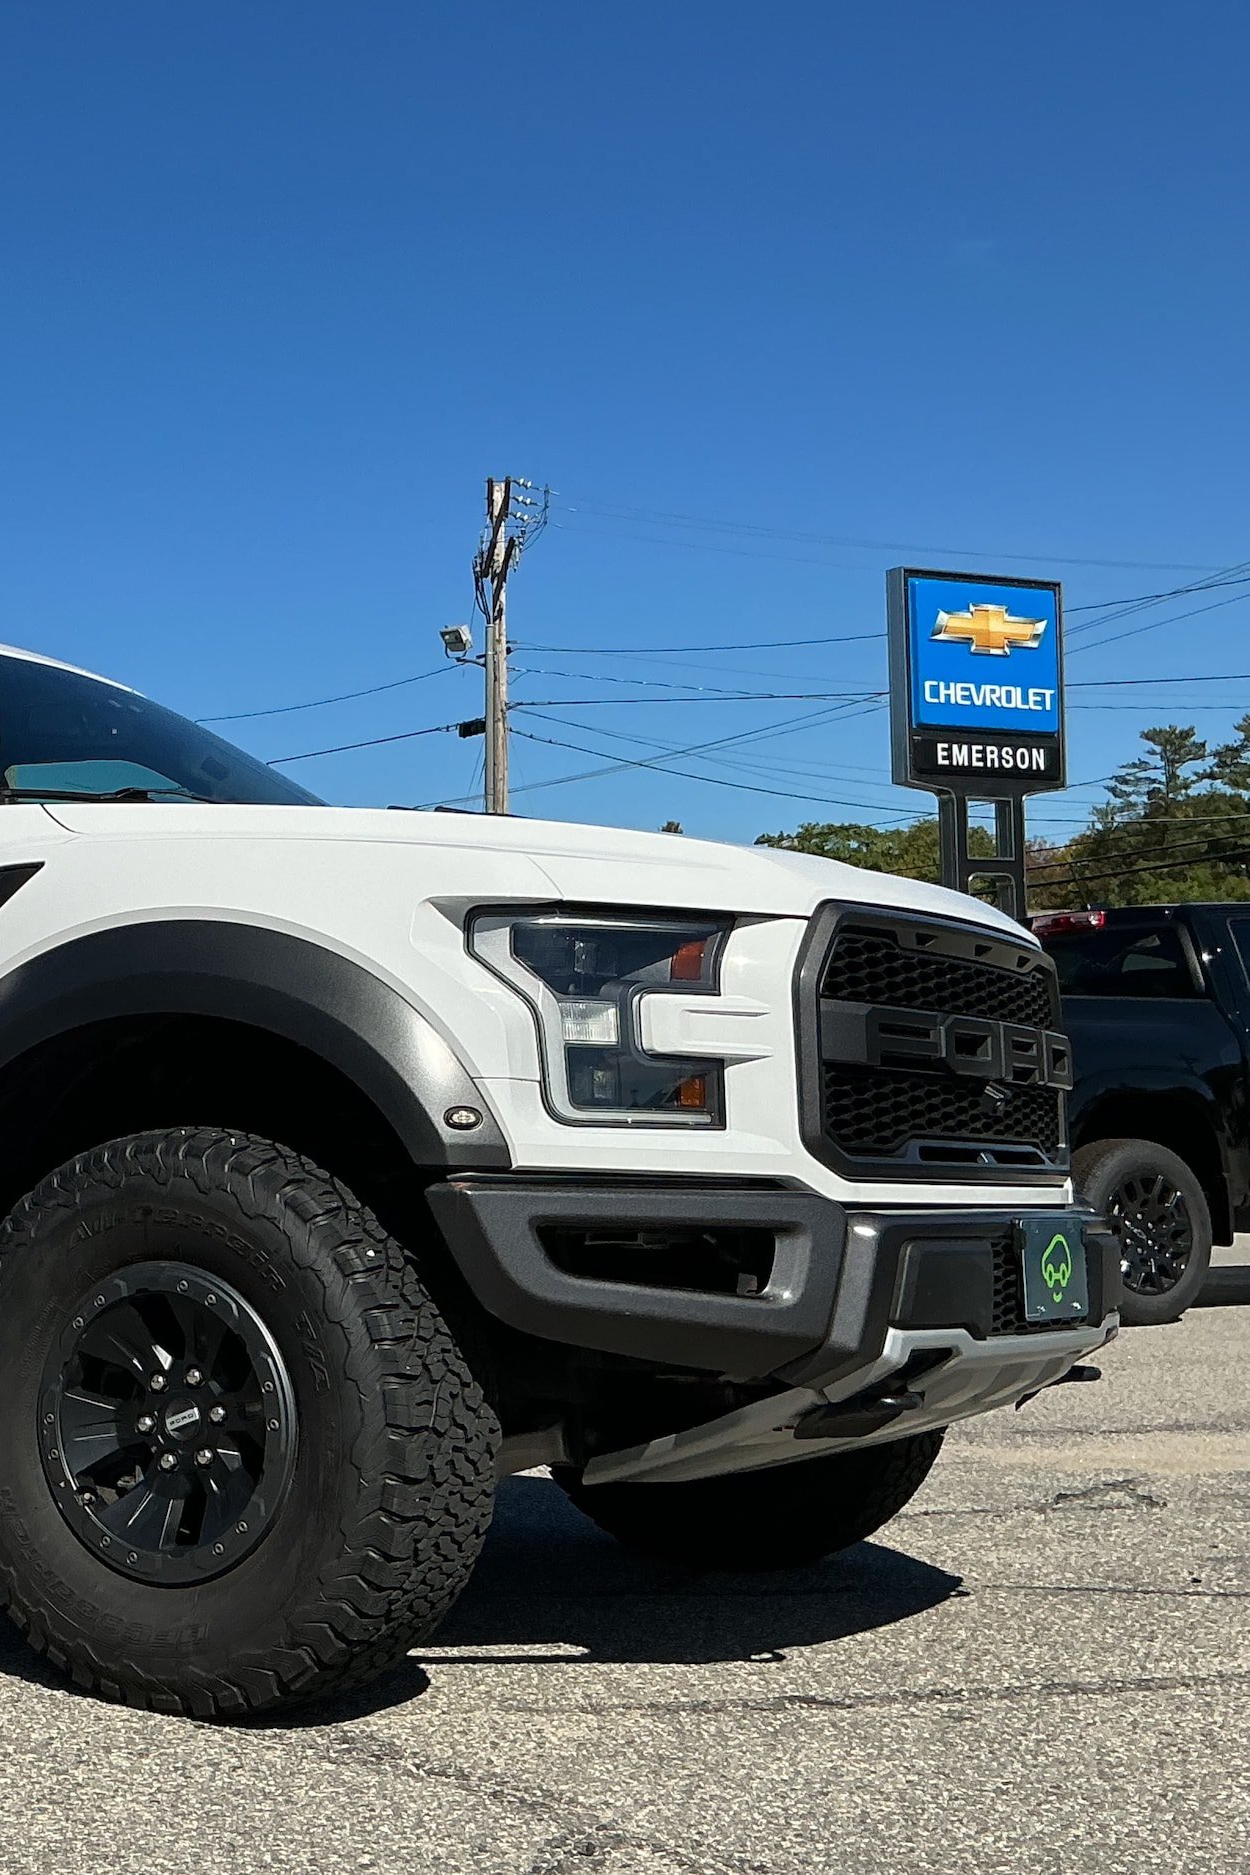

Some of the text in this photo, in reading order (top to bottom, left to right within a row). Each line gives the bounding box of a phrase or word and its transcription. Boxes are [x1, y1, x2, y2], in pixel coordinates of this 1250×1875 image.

[923, 680, 1055, 711] CHEVROLET
[936, 742, 1046, 771] EMERSON
[865, 1006, 1074, 1091] FORD
